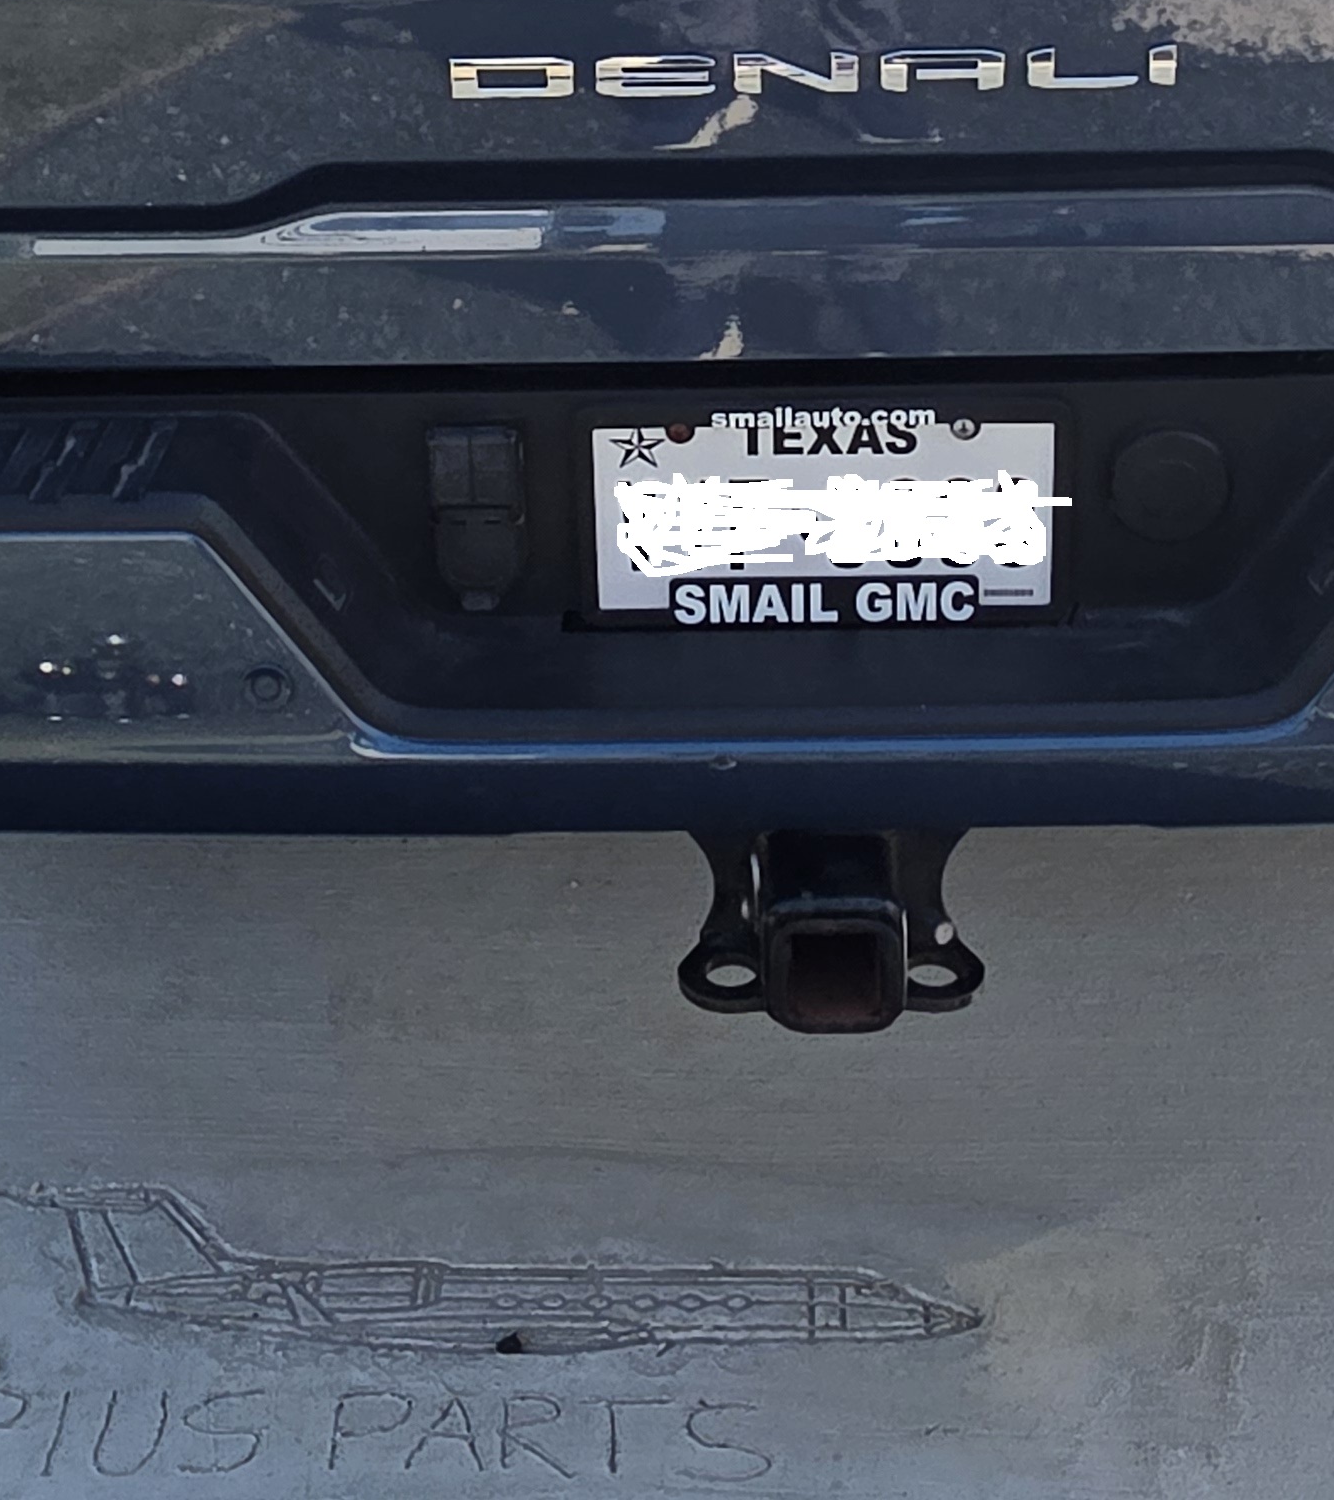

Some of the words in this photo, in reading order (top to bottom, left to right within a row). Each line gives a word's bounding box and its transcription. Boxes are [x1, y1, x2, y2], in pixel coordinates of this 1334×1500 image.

[448, 43, 1178, 98] DENALI
[746, 424, 918, 456] TEXAS
[674, 583, 839, 624] SMAIL
[854, 581, 975, 623] GMC
[327, 1388, 773, 1482] PARTS
